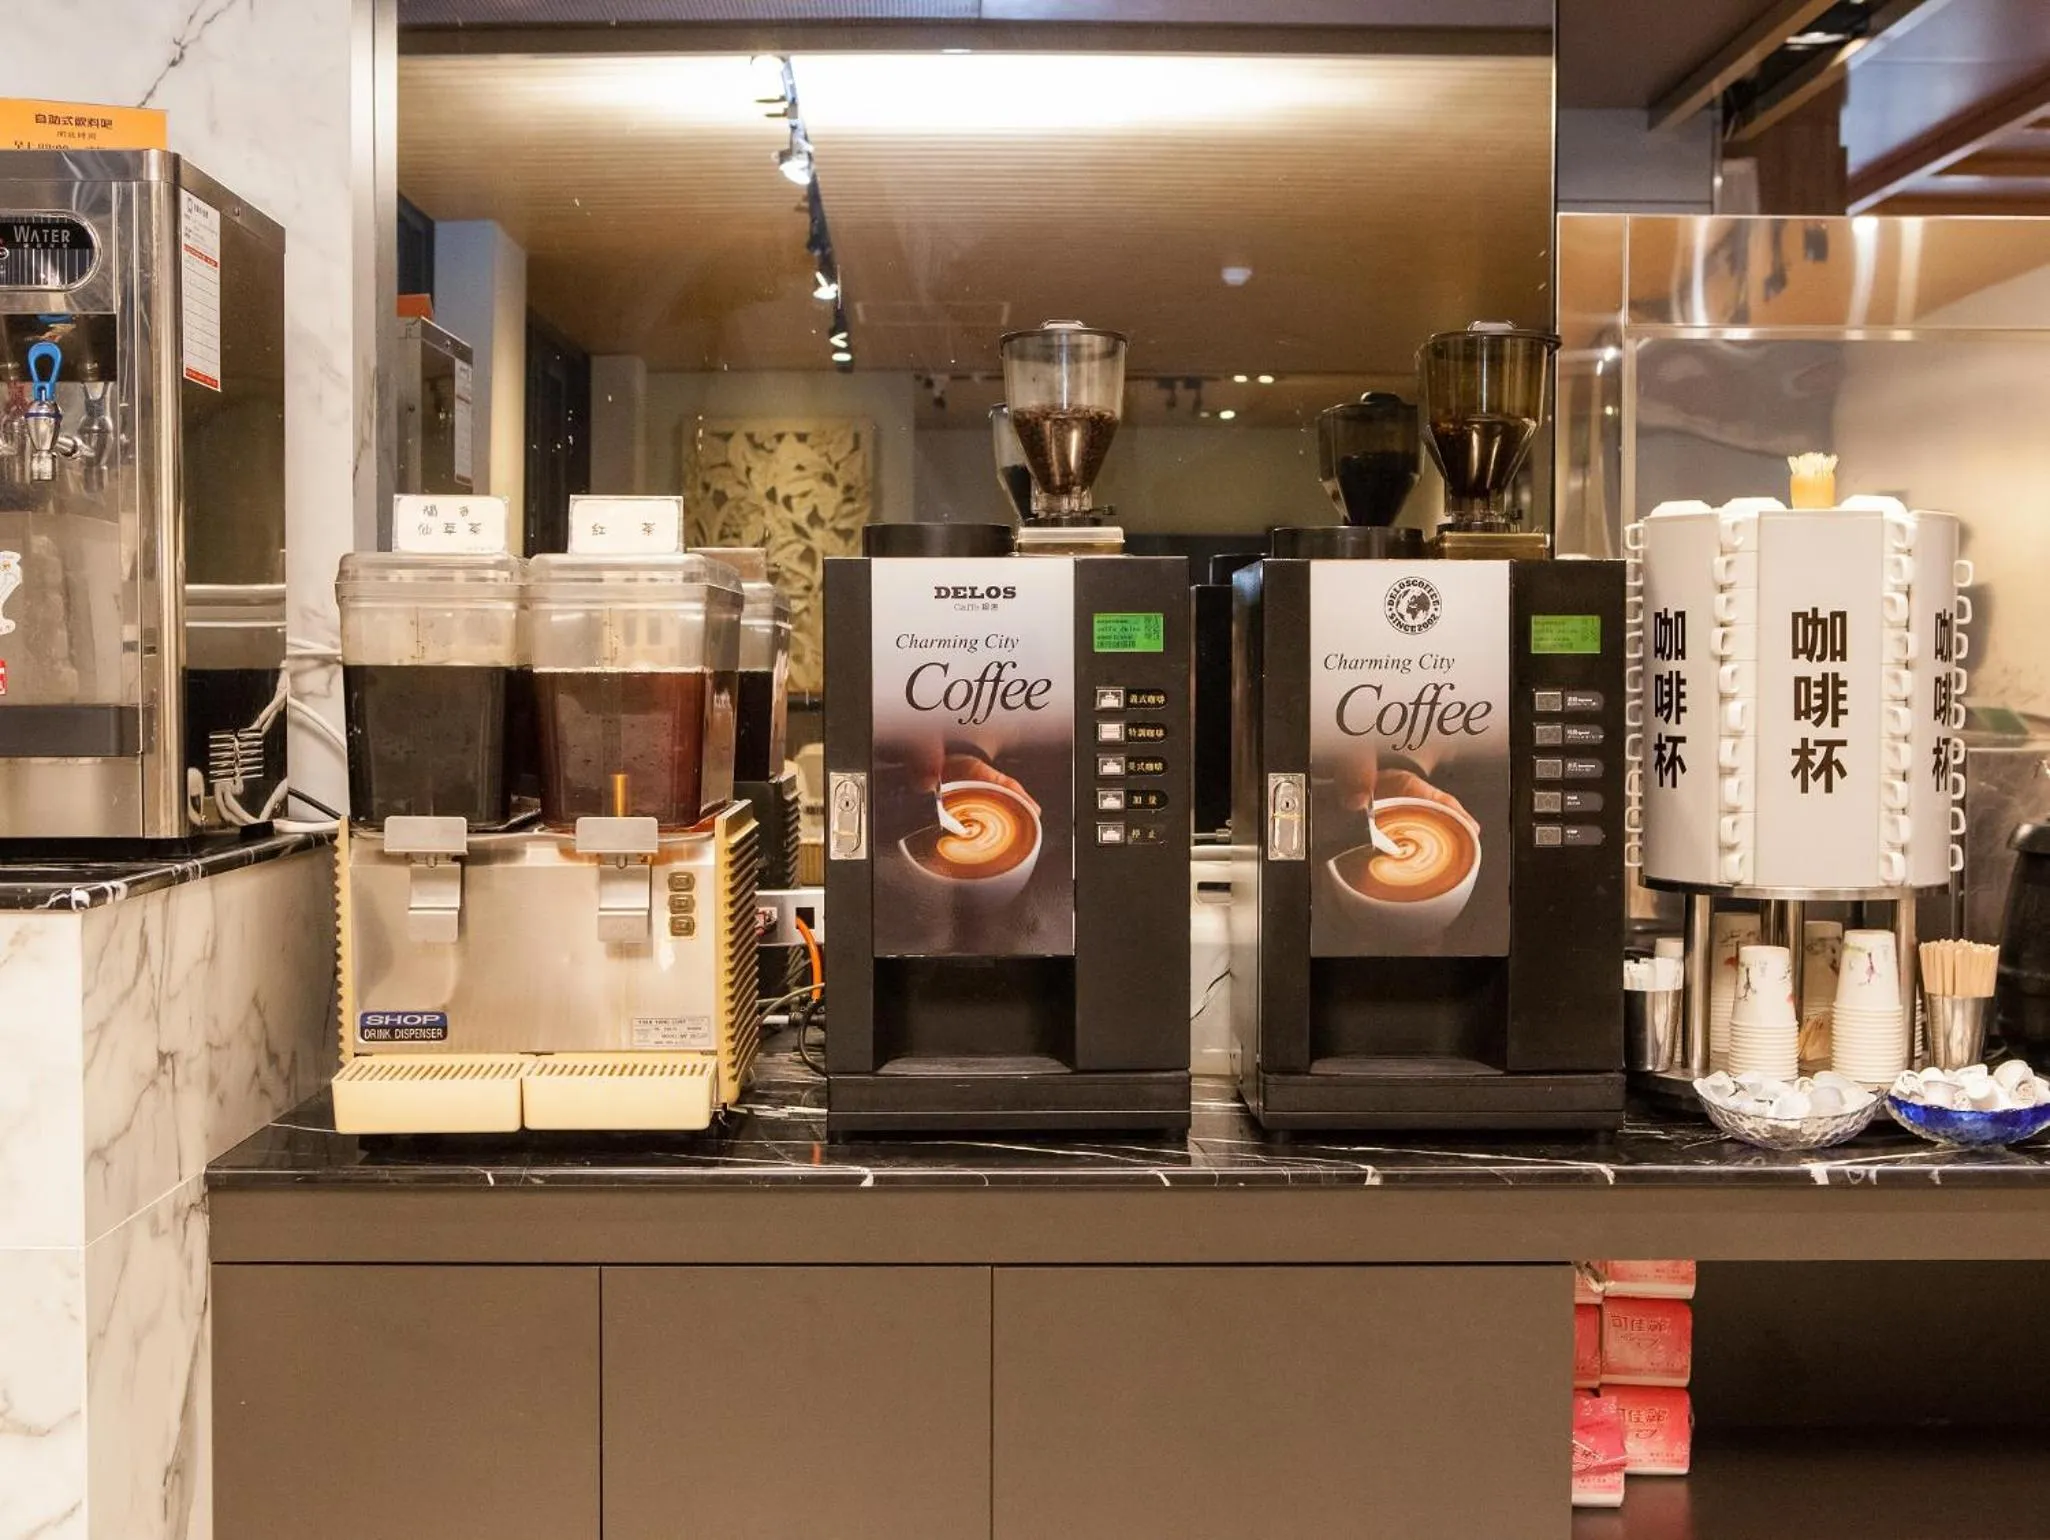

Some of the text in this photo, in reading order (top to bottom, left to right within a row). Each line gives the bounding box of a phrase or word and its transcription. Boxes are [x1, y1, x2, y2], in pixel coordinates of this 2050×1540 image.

[13, 225, 71, 243] WATER
[934, 586, 1017, 599] DELOS
[895, 633, 1020, 653] Charming City
[1323, 653, 1455, 674] Charming City
[905, 660, 1052, 725] Coffee
[1654, 608, 1687, 788] 咖啡杯
[1791, 607, 1848, 794] 咖啡杯
[1335, 682, 1493, 751] Coffee
[366, 1014, 440, 1026] SHOP
[364, 1028, 444, 1039] DRINK DISPENSER
